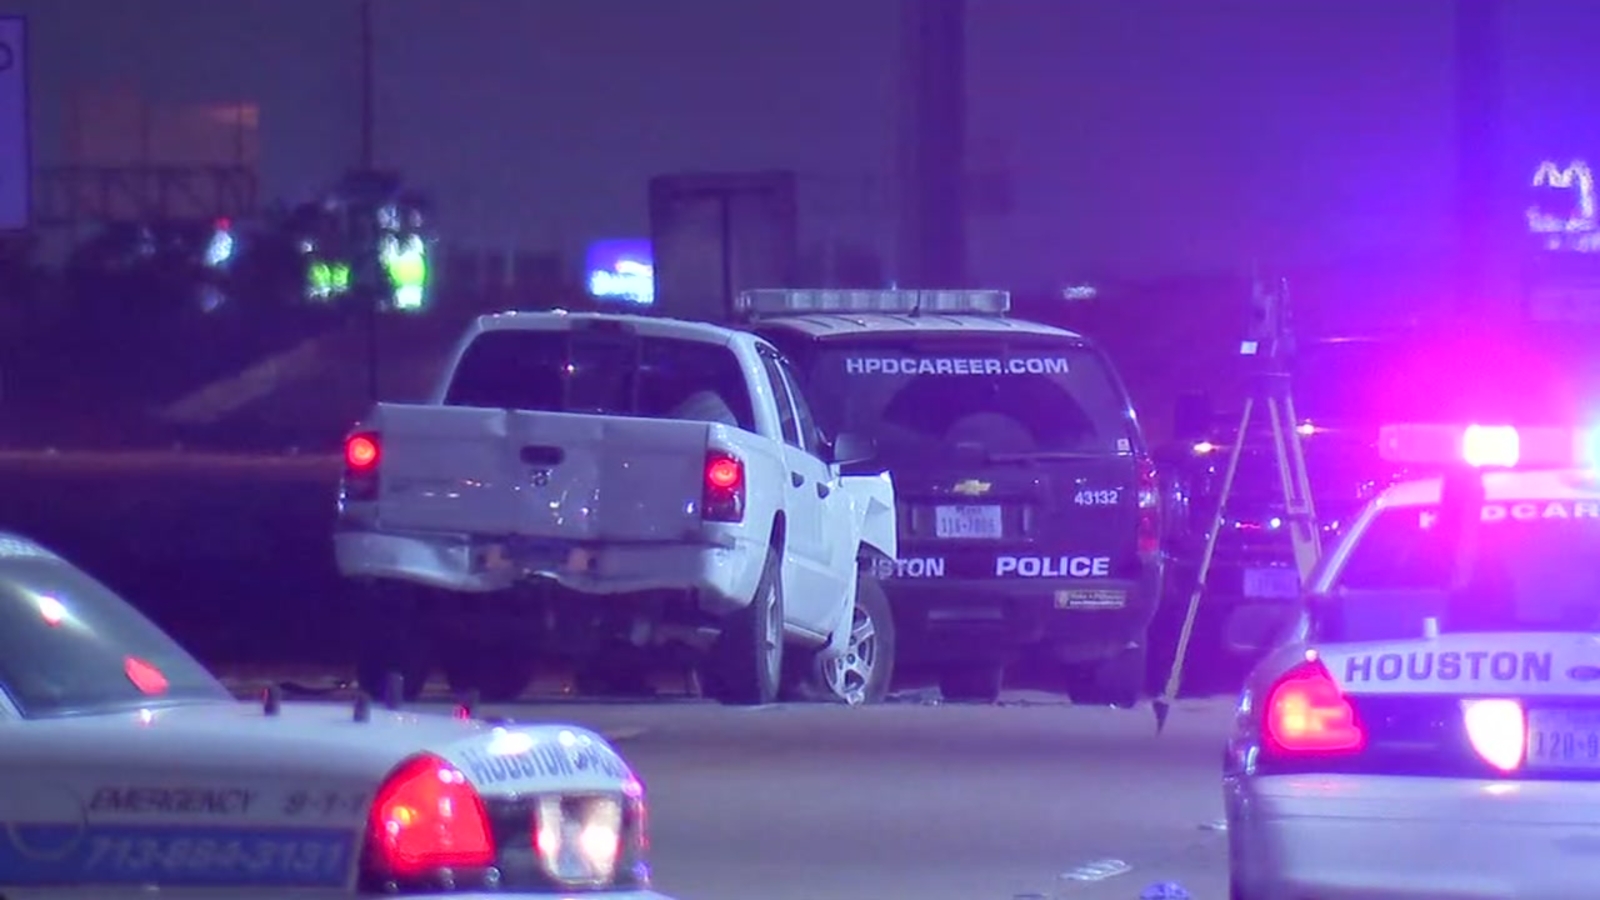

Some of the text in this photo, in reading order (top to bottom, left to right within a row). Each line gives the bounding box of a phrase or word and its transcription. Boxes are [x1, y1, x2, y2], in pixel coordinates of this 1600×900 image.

[846, 357, 1069, 375] HPDCAREER.COM
[1074, 490, 1118, 506] 43132
[871, 557, 1110, 577] STON POLICE
[1345, 651, 1553, 683] HOUSTON
[90, 787, 254, 814] EMERGENCY
